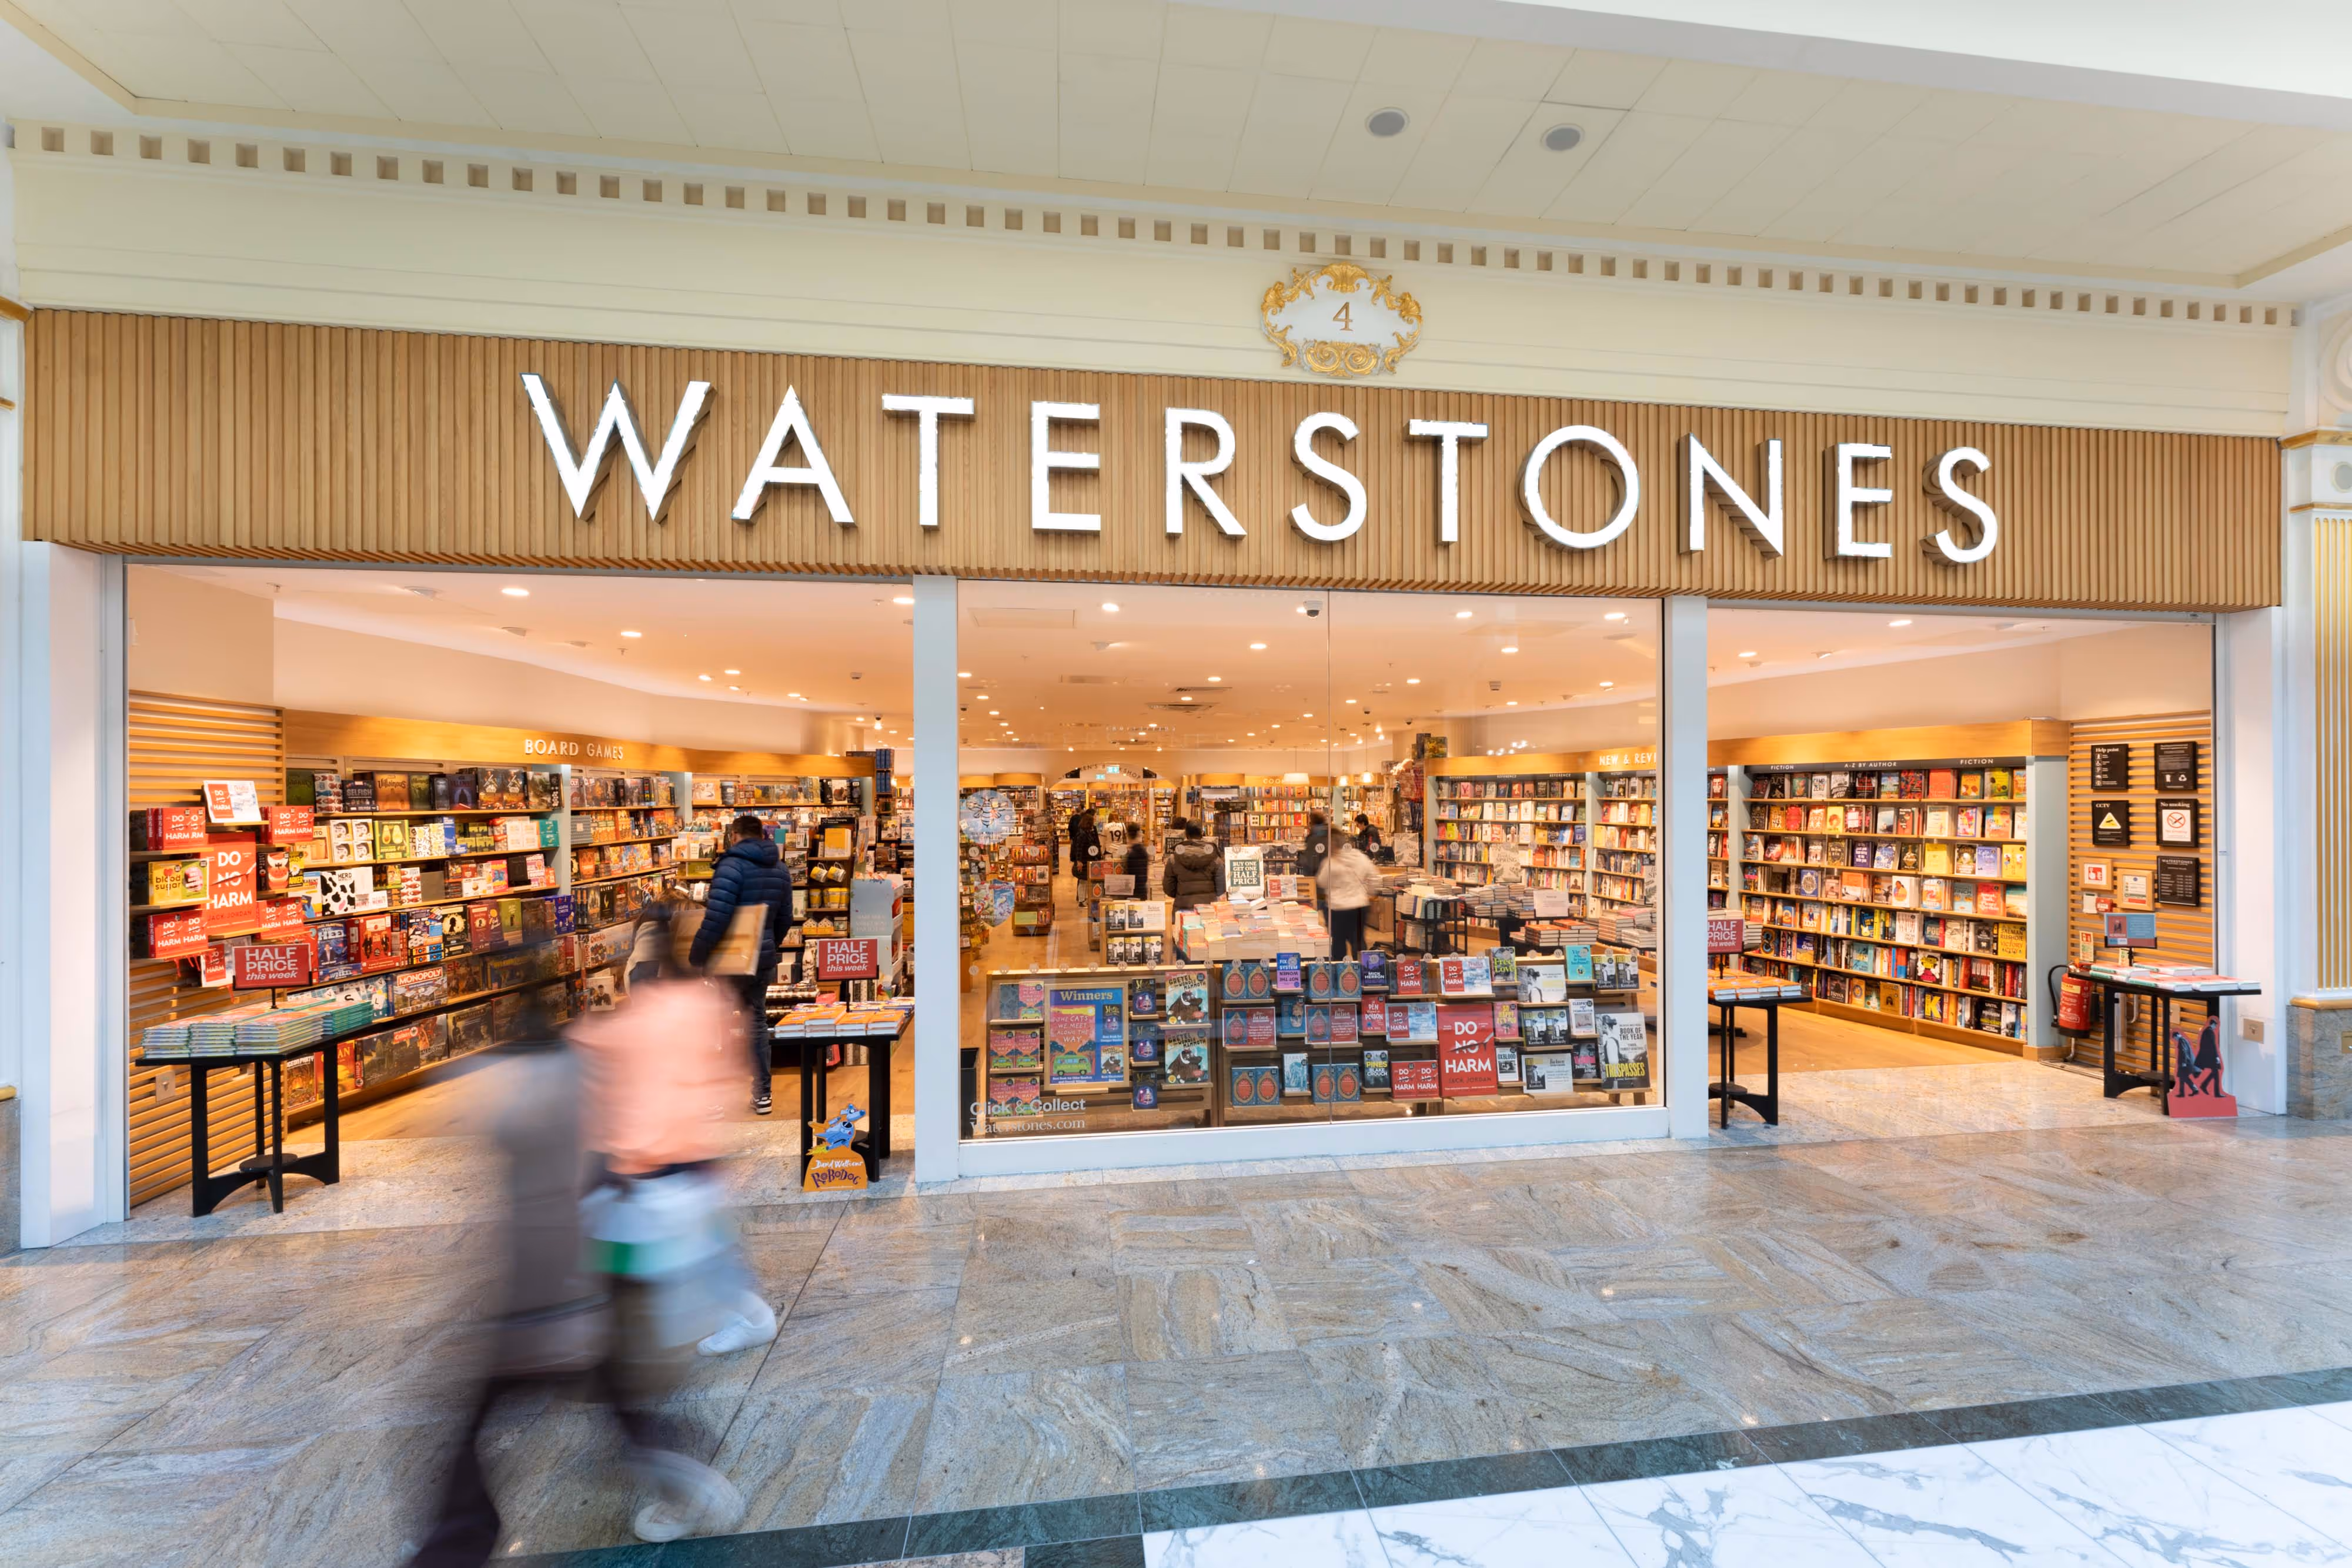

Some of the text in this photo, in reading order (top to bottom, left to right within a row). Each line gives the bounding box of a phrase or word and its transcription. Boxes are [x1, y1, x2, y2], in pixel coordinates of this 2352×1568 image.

[1331, 302, 1355, 332] 4
[520, 372, 1999, 566] WATERSTONES
[525, 738, 623, 760] BOARD GAMES
[1599, 754, 1618, 765] NEW
[1623, 754, 1630, 764] &
[378, 779, 406, 788] Villainous
[1110, 830, 1121, 841] 19
[218, 851, 241, 867] DO
[156, 875, 181, 883] blood
[218, 871, 241, 887] NO
[206, 890, 252, 910] HARM
[1708, 921, 1737, 931] HALF
[183, 934, 206, 942] HARM
[1708, 931, 1737, 940] PRICE
[158, 939, 181, 947] HARM
[827, 941, 868, 953] HALF
[246, 947, 296, 961] HALF
[827, 953, 868, 964] PRICE
[246, 959, 298, 972] PRICE
[246, 971, 266, 980] this
[399, 969, 442, 985] MONOPOLY
[1169, 975, 1192, 985] GRETEL
[1060, 992, 1112, 1001] Winners
[1930, 996, 1942, 1019] K
[1455, 1021, 1477, 1035] DO
[1168, 1033, 1191, 1043] GRETEL
[1184, 1039, 1206, 1048] MAMMOTH
[1455, 1040, 1479, 1054] NO
[1445, 1058, 1491, 1073] HARM
[1605, 1063, 1645, 1077] TRESPASSES
[970, 1098, 1086, 1116] Click & Collect
[970, 1119, 1085, 1135] Waterstones.com
[811, 1160, 834, 1170] David
